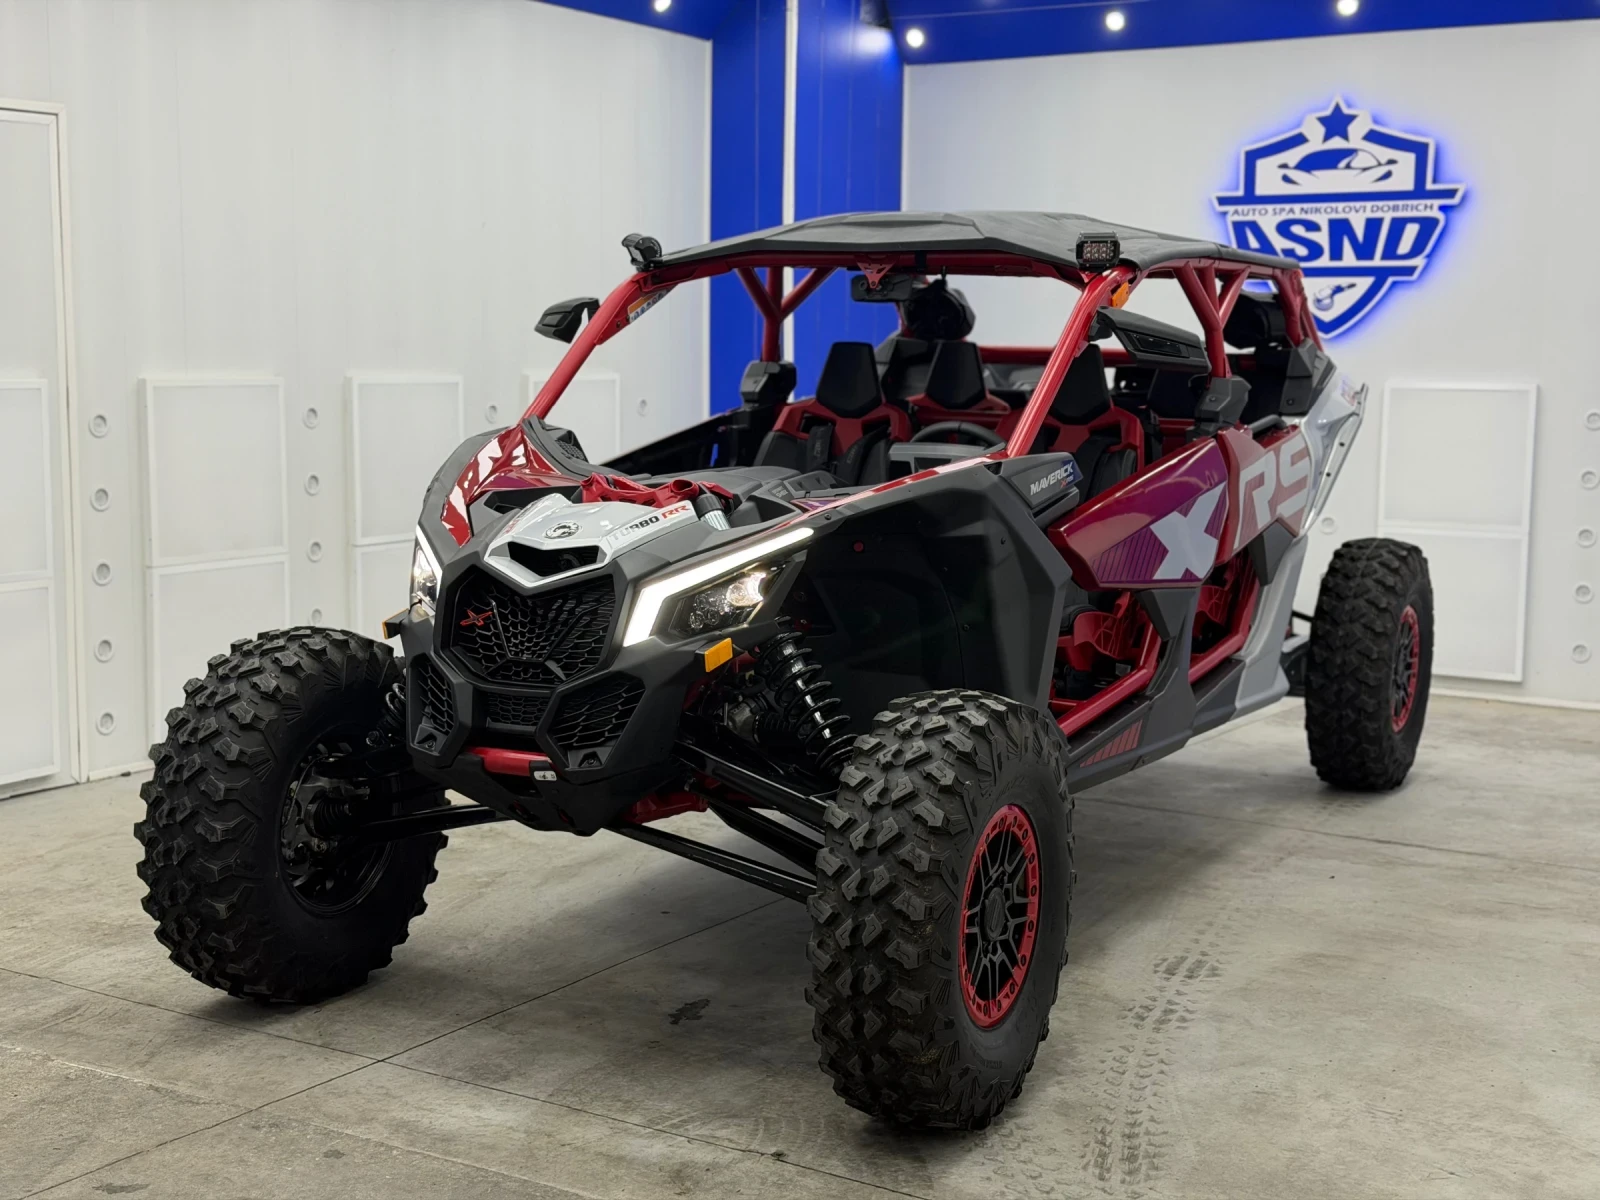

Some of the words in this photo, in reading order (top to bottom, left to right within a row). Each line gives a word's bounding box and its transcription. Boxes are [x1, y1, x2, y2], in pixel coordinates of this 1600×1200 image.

[1231, 207, 1268, 217] AUTO
[1272, 206, 1296, 216] SPA
[1299, 204, 1367, 215] NIKOLOVI
[1370, 203, 1434, 213] DOBRICH
[1231, 216, 1440, 263] ASND
[1030, 461, 1074, 496] MAVERICK
[608, 515, 660, 541] TURBO
[661, 505, 690, 519] RR
